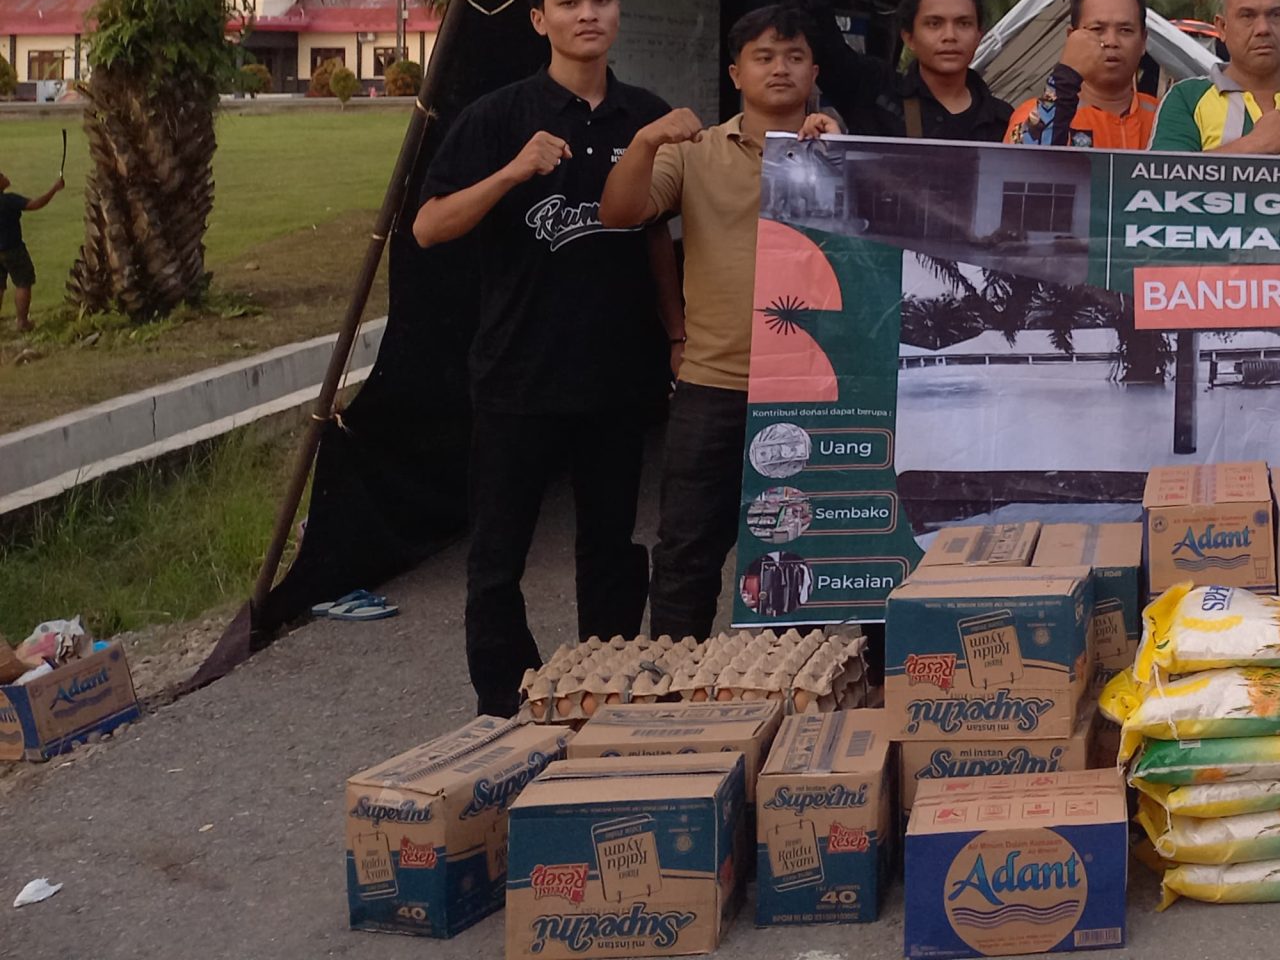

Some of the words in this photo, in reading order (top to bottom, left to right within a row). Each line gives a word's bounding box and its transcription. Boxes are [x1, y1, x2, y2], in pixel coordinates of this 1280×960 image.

[1131, 162, 1226, 181] ALIANSI
[1123, 190, 1246, 215] AKSI
[752, 408, 798, 417] Kontribusi
[799, 407, 829, 417] donasi
[829, 407, 856, 417] dapat
[820, 440, 872, 457] Uang
[815, 506, 890, 520] Sembako
[1171, 524, 1253, 558] Adant
[817, 573, 894, 590] Pakaian
[1201, 586, 1230, 611] SPH
[972, 641, 1010, 660] Kaldu
[906, 657, 955, 676] Resep
[965, 723, 998, 732] instan
[997, 723, 1010, 732] mi
[959, 748, 971, 758] mi
[972, 747, 1004, 758] instan
[603, 837, 645, 858] Ayam
[606, 851, 648, 871] Kaldu
[531, 868, 586, 888] Resep
[947, 850, 1082, 906] Adant
[820, 890, 857, 904] 40
[398, 906, 426, 920] 40
[596, 940, 631, 949] instan
[631, 941, 646, 949] mi
